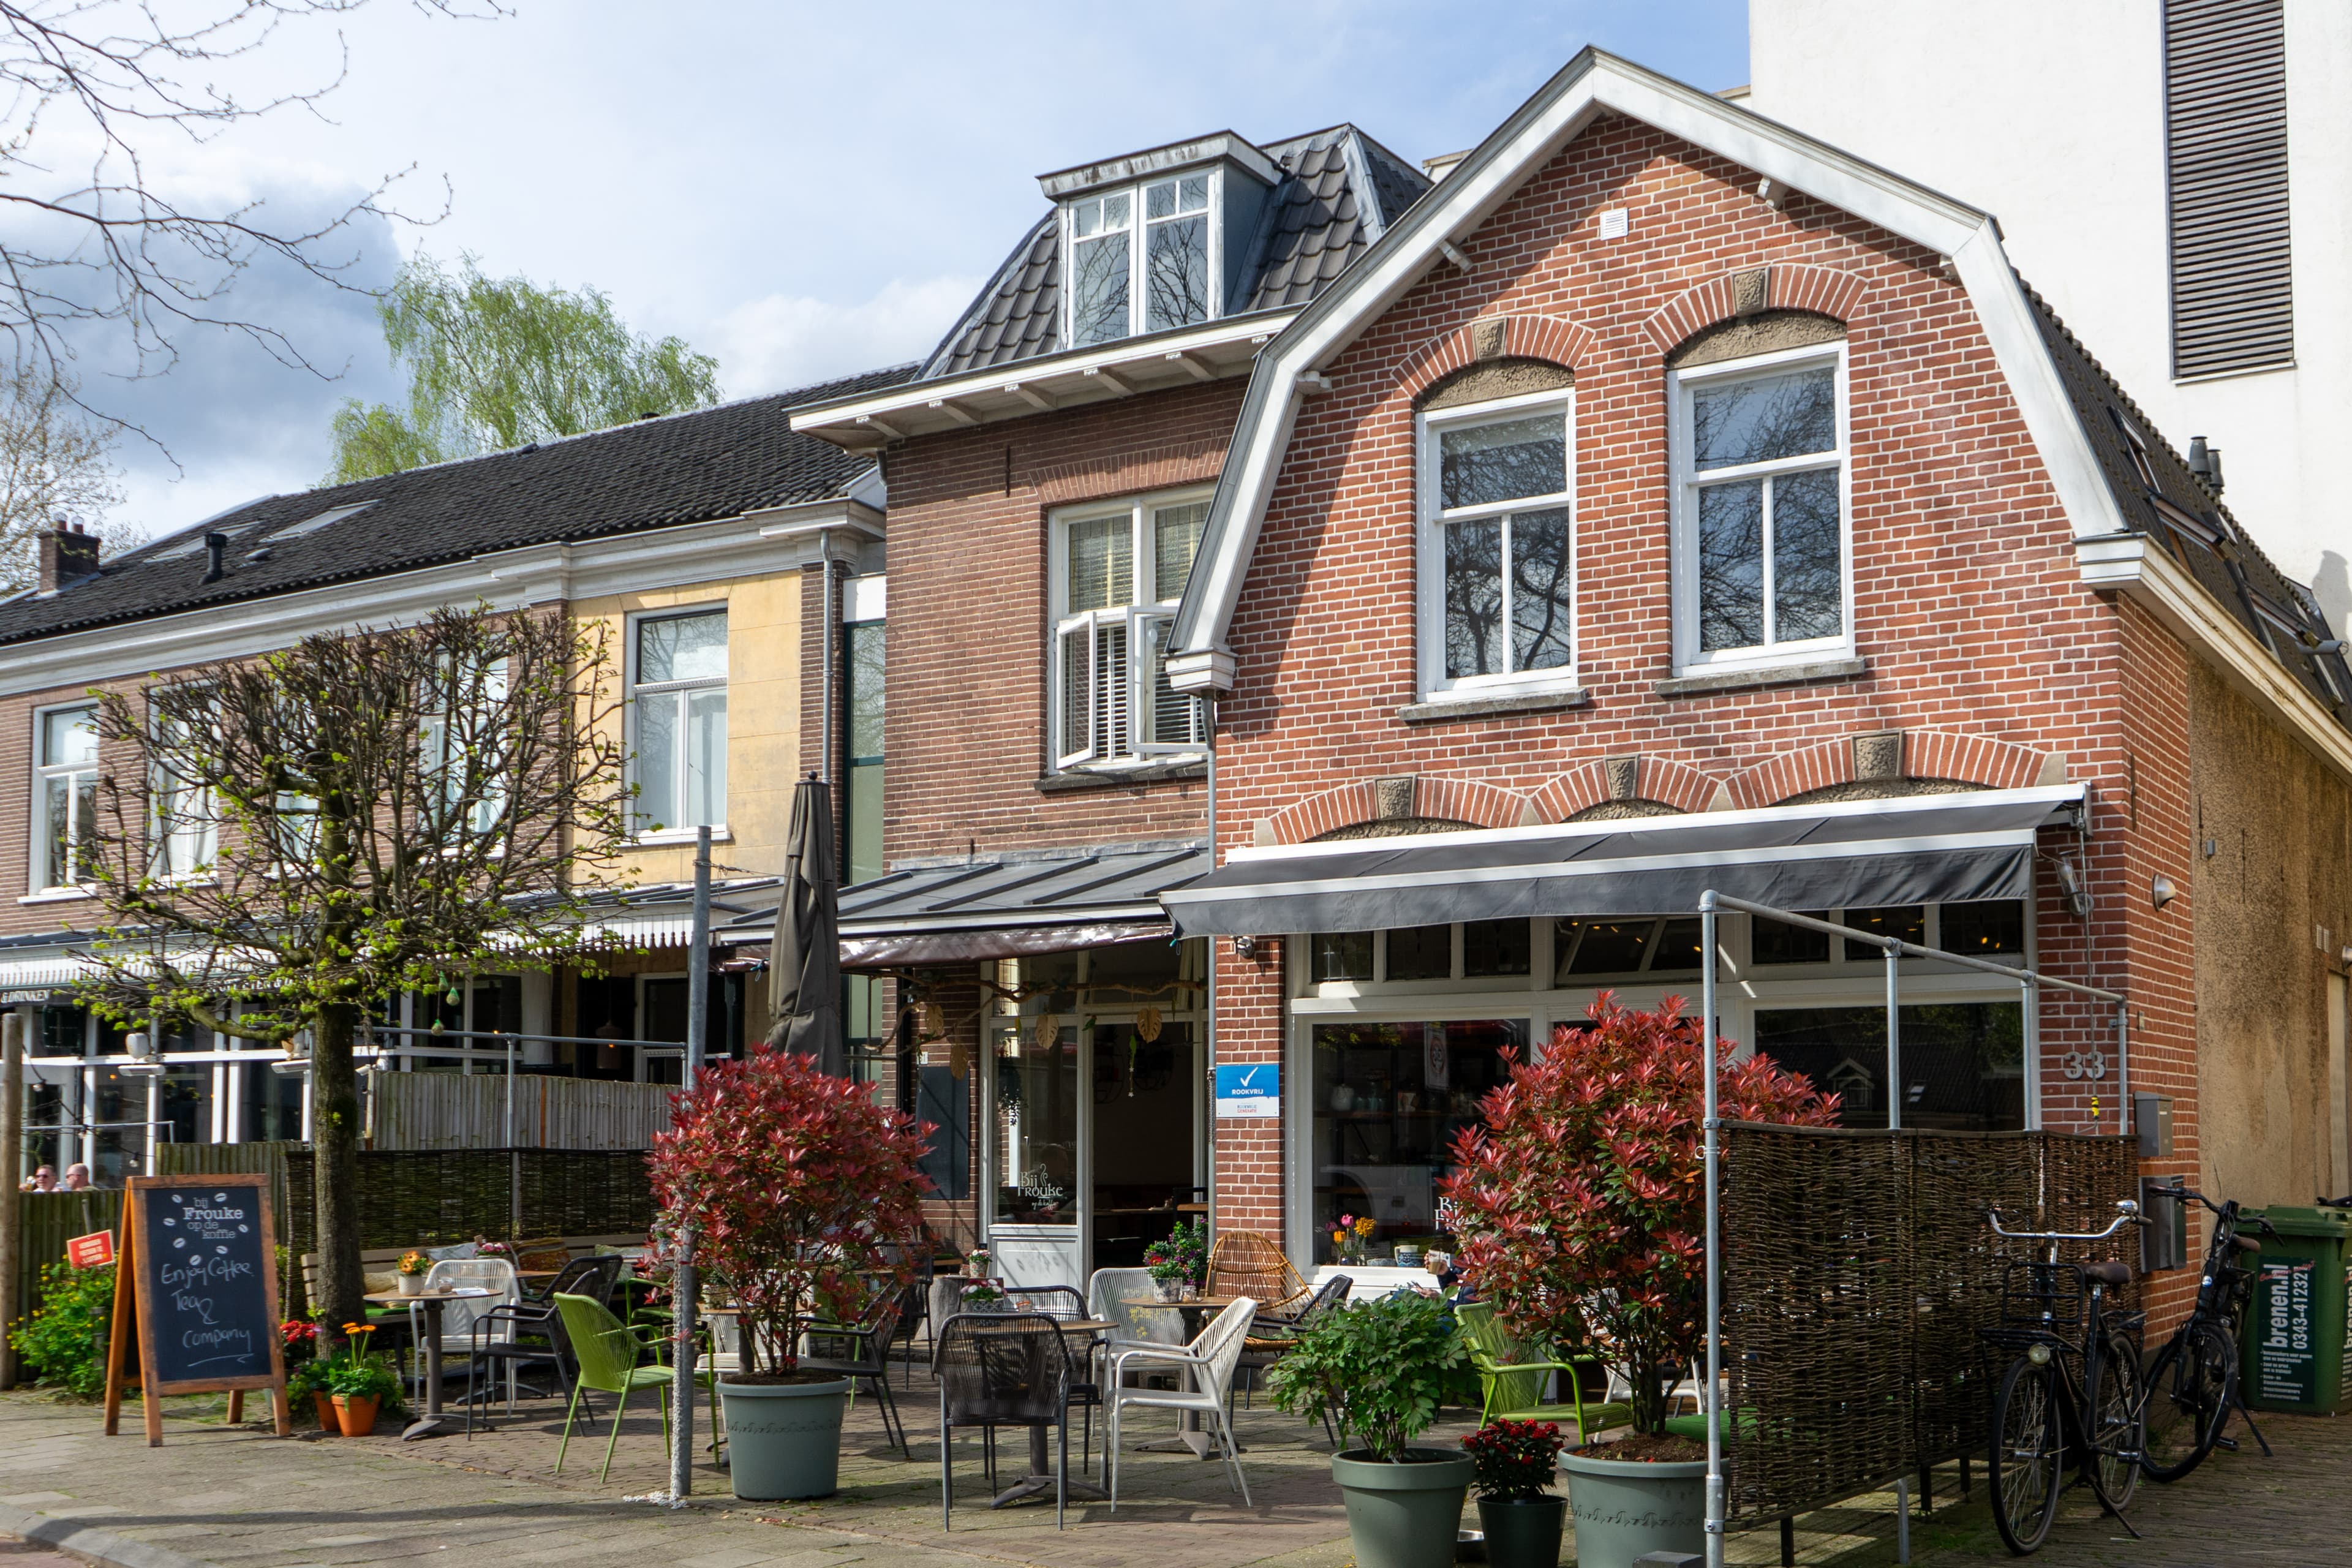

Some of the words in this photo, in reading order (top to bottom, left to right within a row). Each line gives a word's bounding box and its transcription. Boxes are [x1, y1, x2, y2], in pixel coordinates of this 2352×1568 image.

[9, 989, 51, 1003] DRINKEN
[2064, 1051, 2105, 1079] 33
[1020, 1172, 1038, 1191] Bij
[193, 1197, 208, 1209] bij
[183, 1207, 244, 1220] Frouke
[187, 1221, 202, 1232] op
[204, 1220, 219, 1229] de
[202, 1229, 236, 1239] koffie
[161, 1263, 208, 1289] Enjoy
[170, 1289, 200, 1311] Tea
[198, 1298, 221, 1325] &
[2263, 1264, 2288, 1348] brenen.nl
